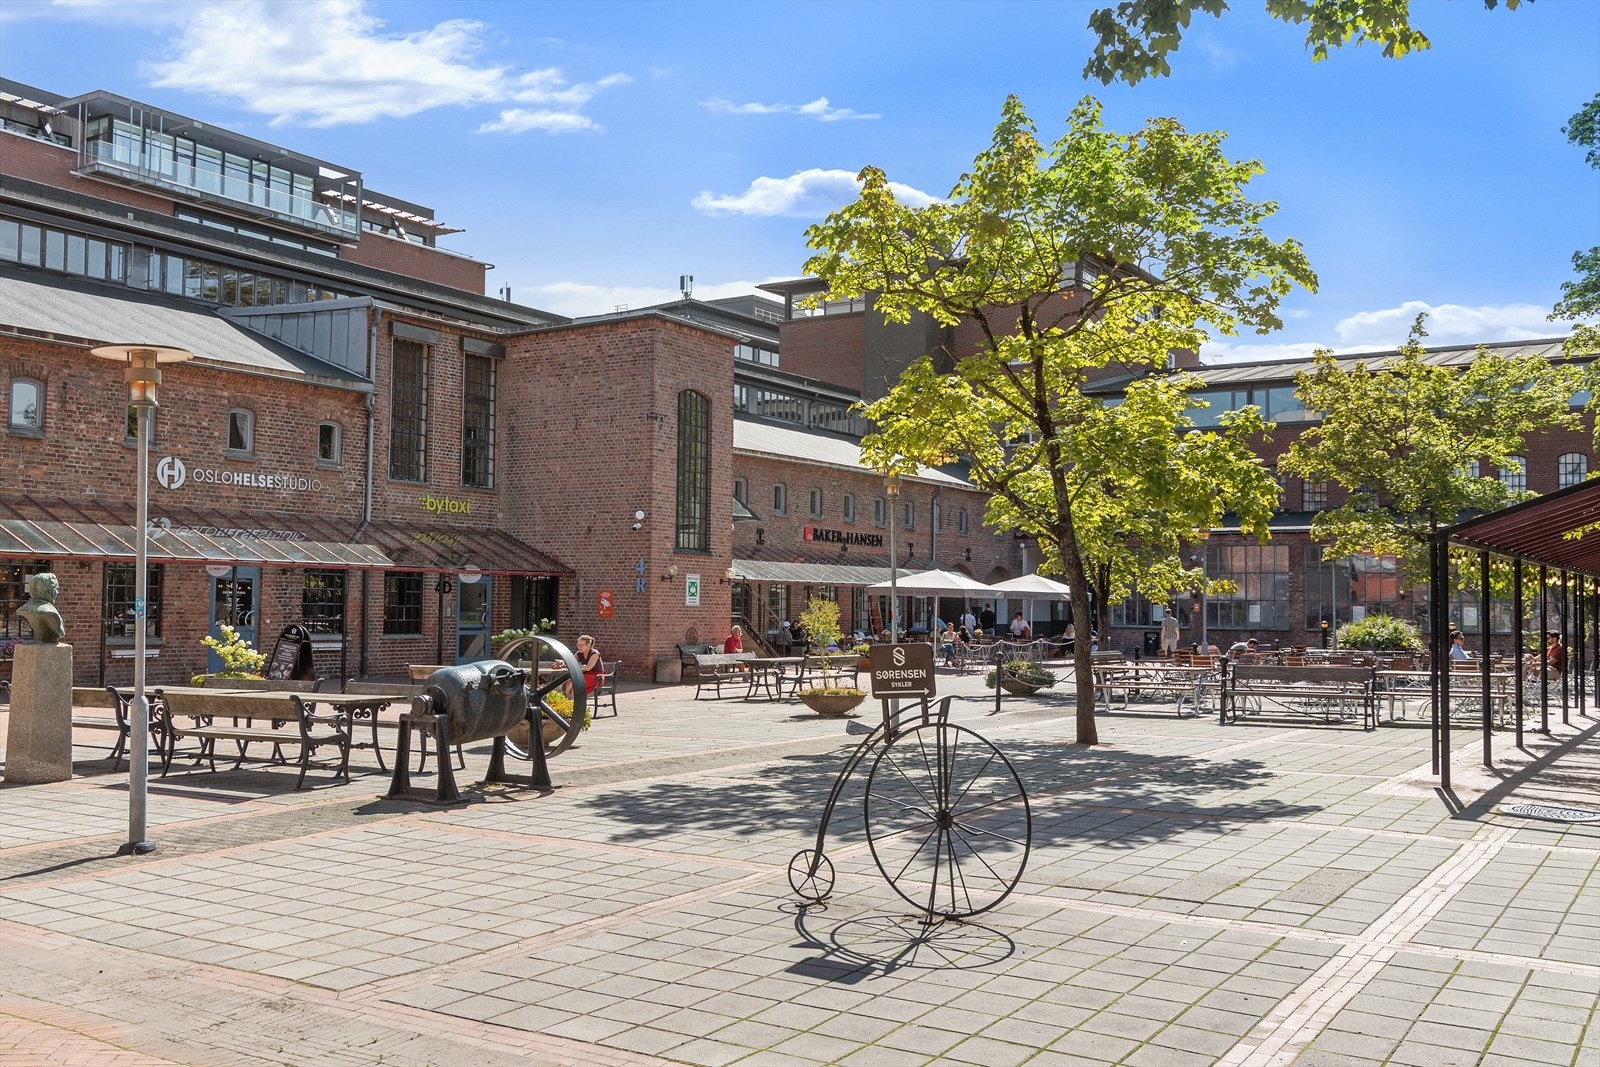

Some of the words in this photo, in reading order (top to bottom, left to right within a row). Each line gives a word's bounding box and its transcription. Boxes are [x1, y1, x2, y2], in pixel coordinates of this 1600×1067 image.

[192, 468, 322, 492] OSLOHELSESTUDIO
[813, 527, 842, 545] BAKER
[846, 531, 883, 548] HANSEN
[635, 556, 646, 576] 4
[635, 577, 647, 593] R
[875, 669, 927, 680] SØRENSEN
